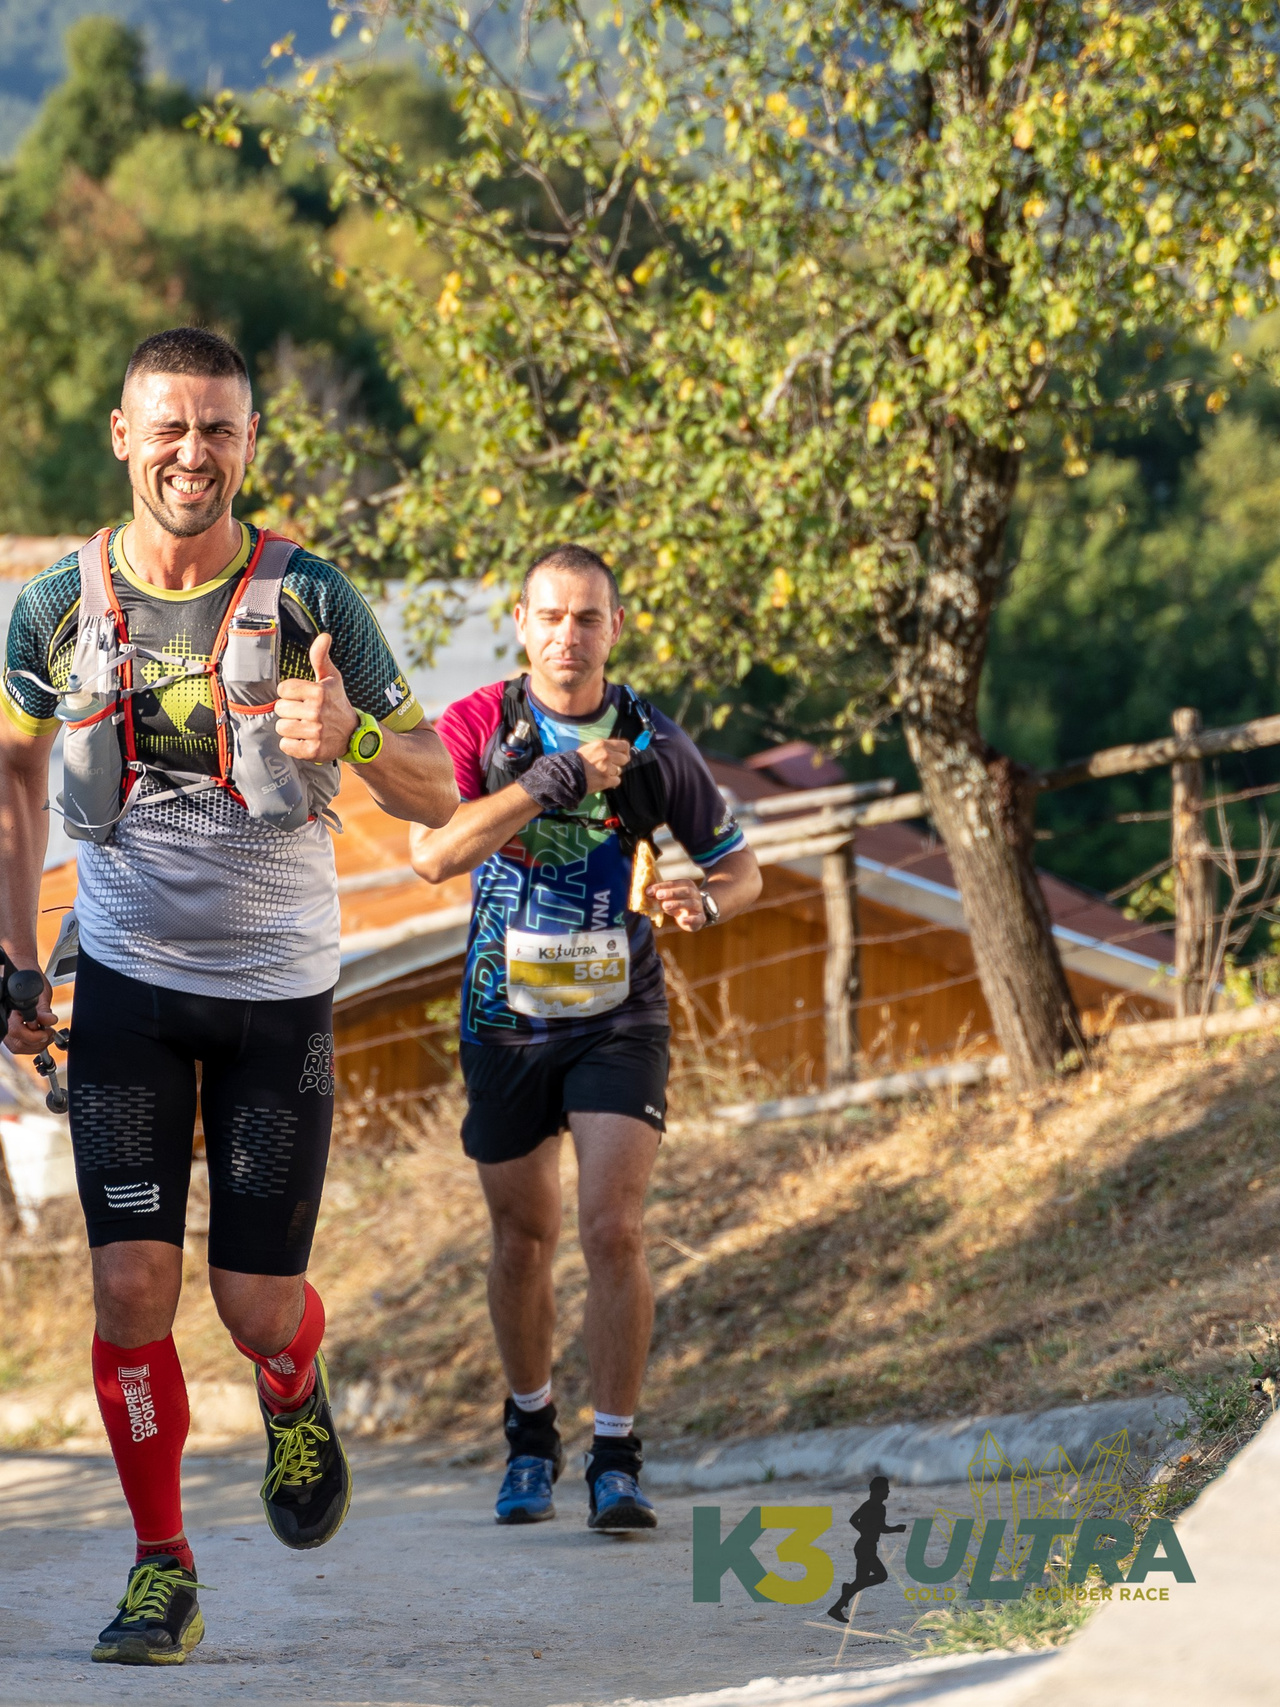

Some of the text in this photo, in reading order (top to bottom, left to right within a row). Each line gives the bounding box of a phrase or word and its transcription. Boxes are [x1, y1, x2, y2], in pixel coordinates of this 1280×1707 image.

[384, 675, 409, 707] K3
[526, 811, 589, 934] TRA
[467, 840, 527, 1034] TRYAV
[538, 947, 557, 960] K3
[563, 945, 598, 958] ULTRA
[574, 960, 620, 980] 564
[307, 1032, 334, 1053] CO
[139, 1394, 158, 1438] SPORT
